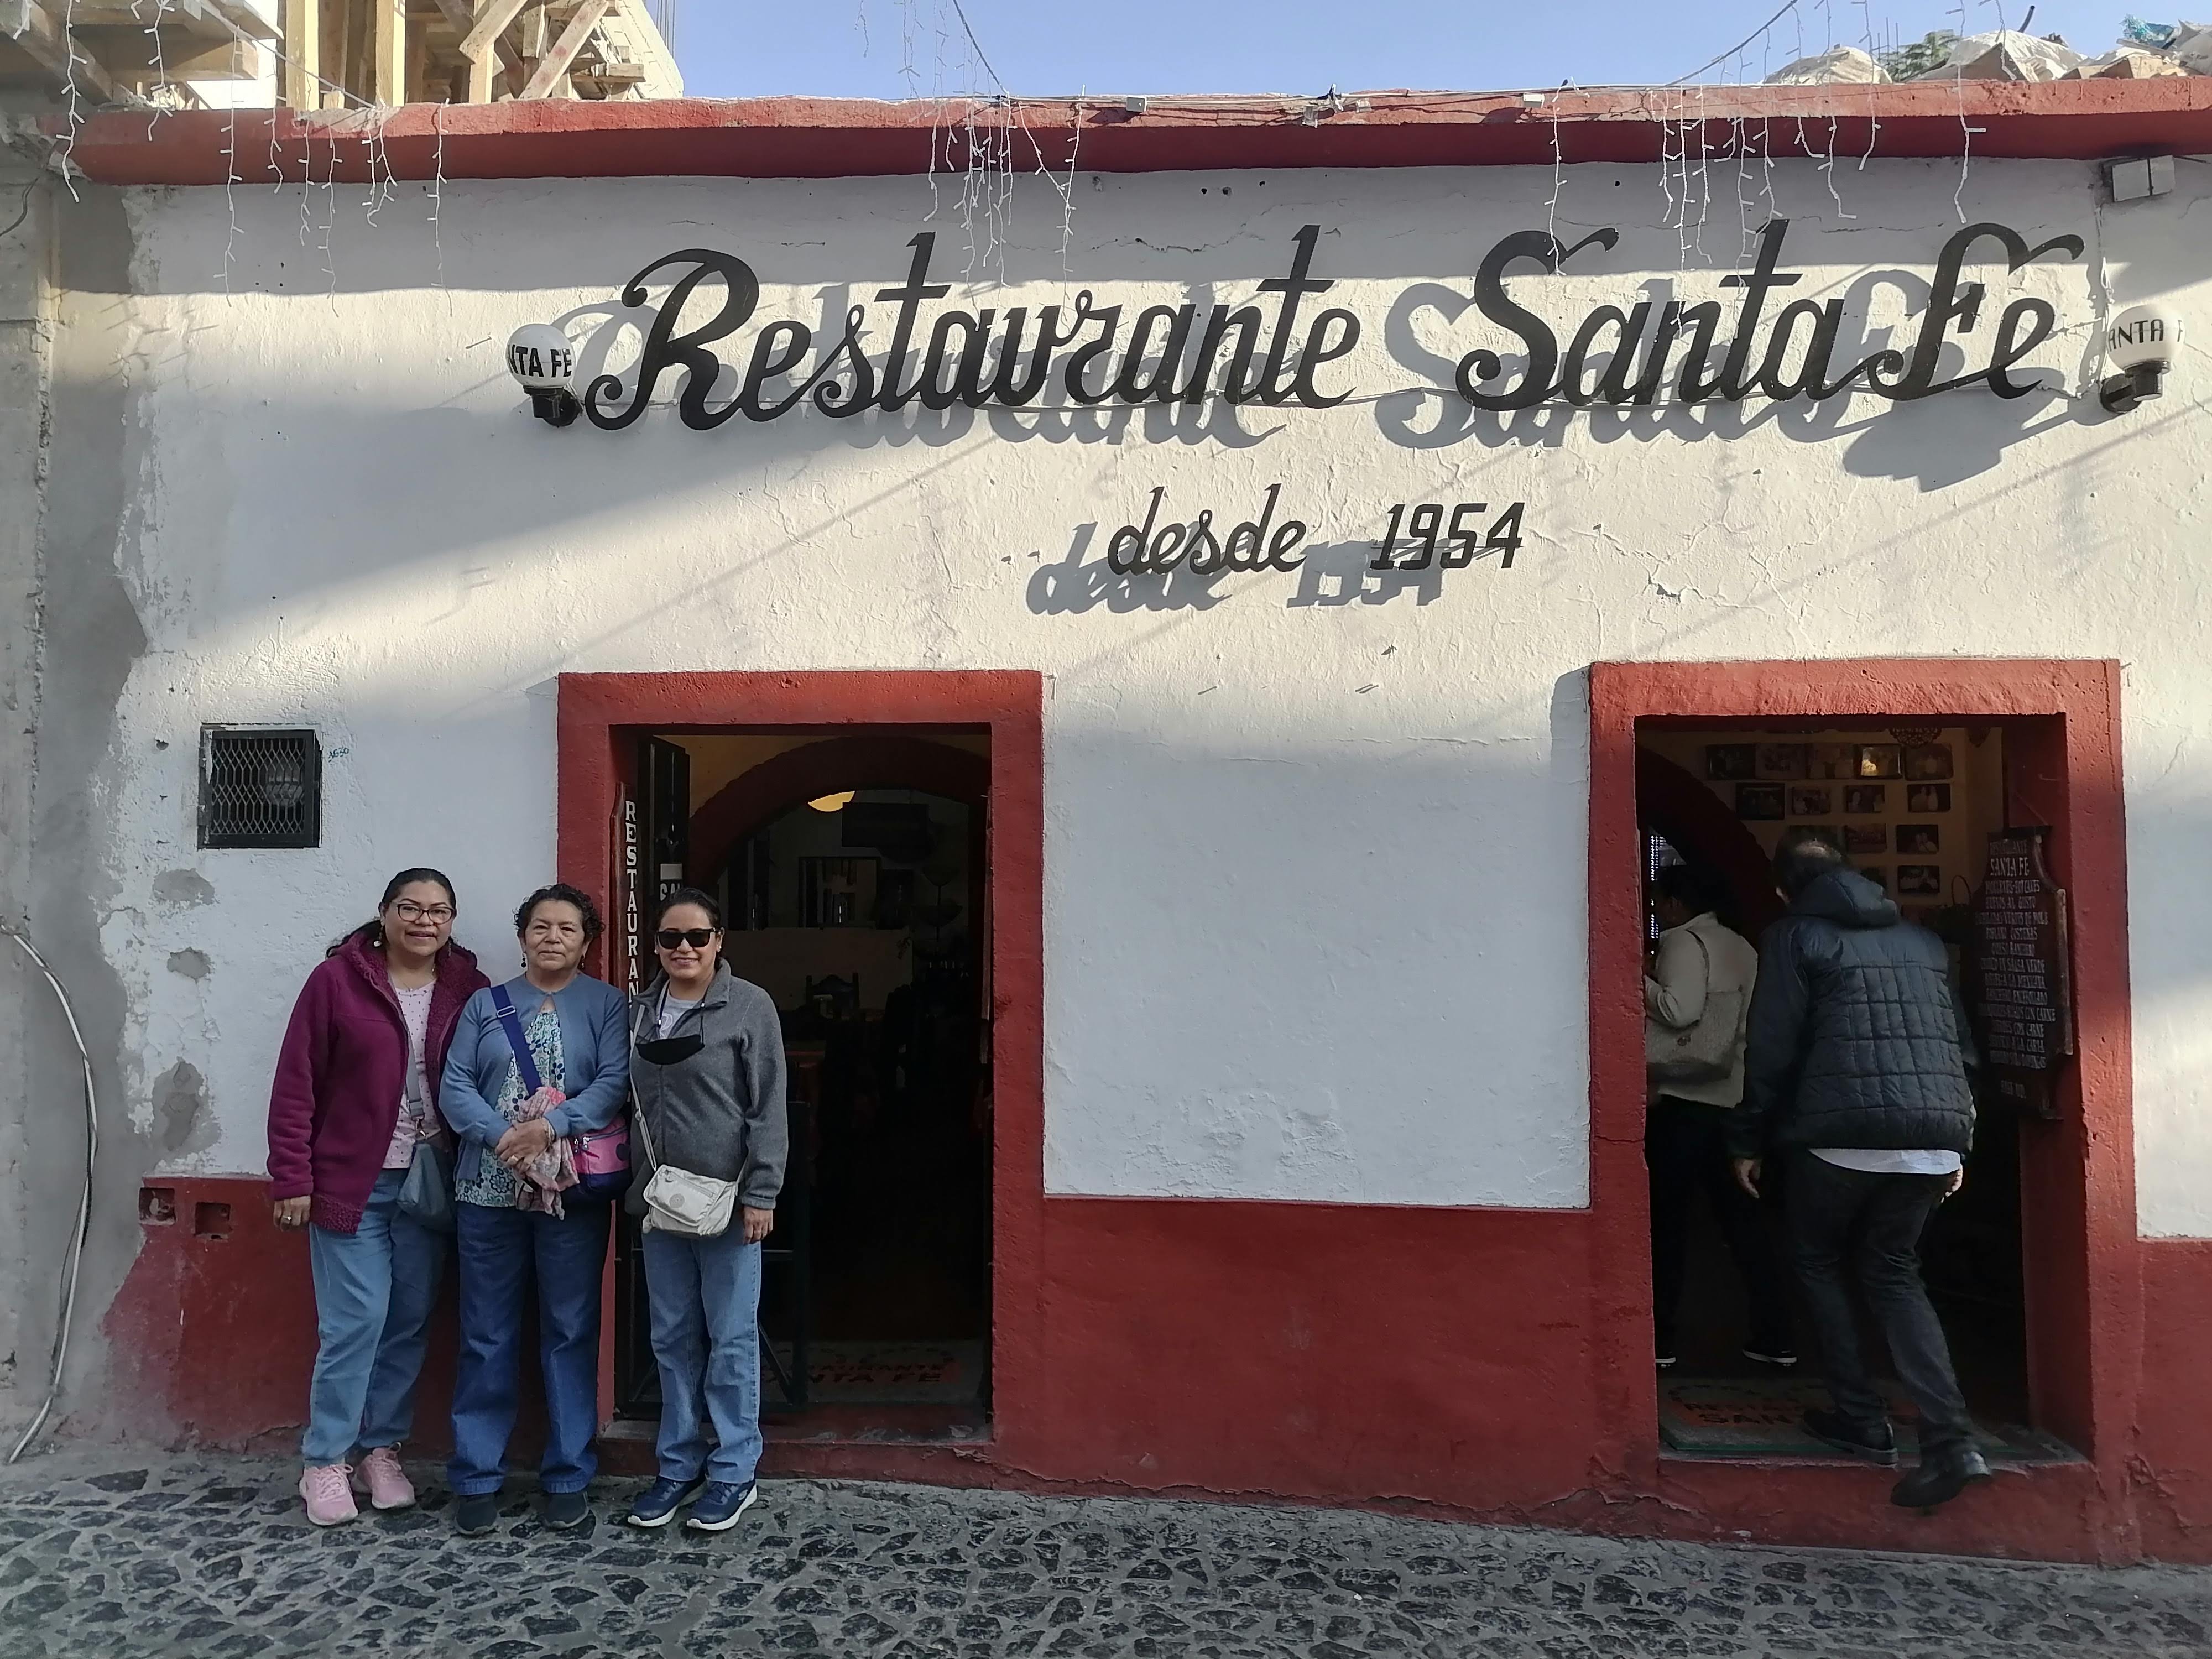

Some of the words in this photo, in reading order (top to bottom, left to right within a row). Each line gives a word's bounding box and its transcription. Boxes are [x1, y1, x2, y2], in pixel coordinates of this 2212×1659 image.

[550, 348, 572, 378] FE
[586, 225, 1361, 430] Restaurante
[1455, 219, 1869, 411] Santa
[1868, 222, 2084, 401] Fe
[1108, 483, 1307, 575] desde
[1369, 502, 1525, 570] 1954
[625, 800, 639, 1009] RESTAURAN
[1990, 857, 2017, 877] SANTA
[2018, 857, 2030, 877] FE
